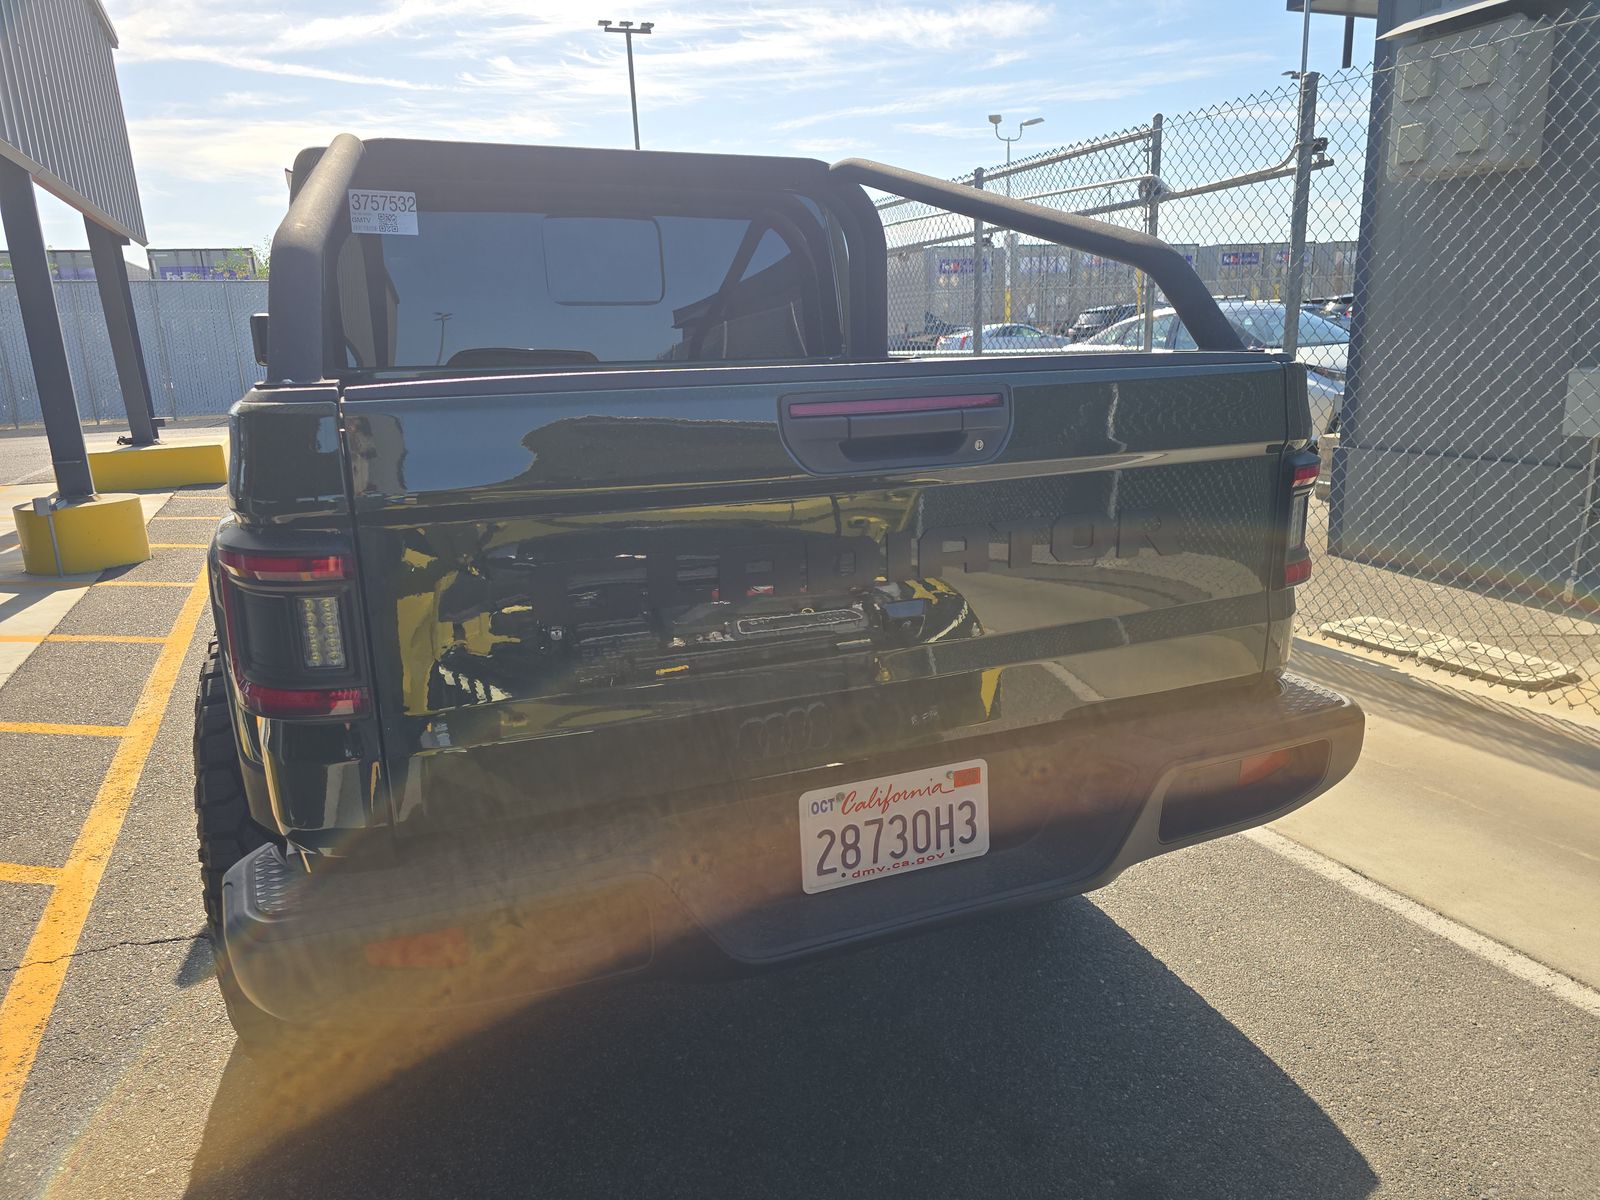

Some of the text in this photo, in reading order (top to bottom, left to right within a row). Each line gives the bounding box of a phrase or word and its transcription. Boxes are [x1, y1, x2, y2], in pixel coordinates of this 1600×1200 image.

[351, 193, 417, 213] 3757532
[811, 799, 835, 815] OCT
[841, 778, 955, 816] California
[816, 800, 978, 877] 28730H3
[851, 852, 945, 879] dmv.ca.gov
